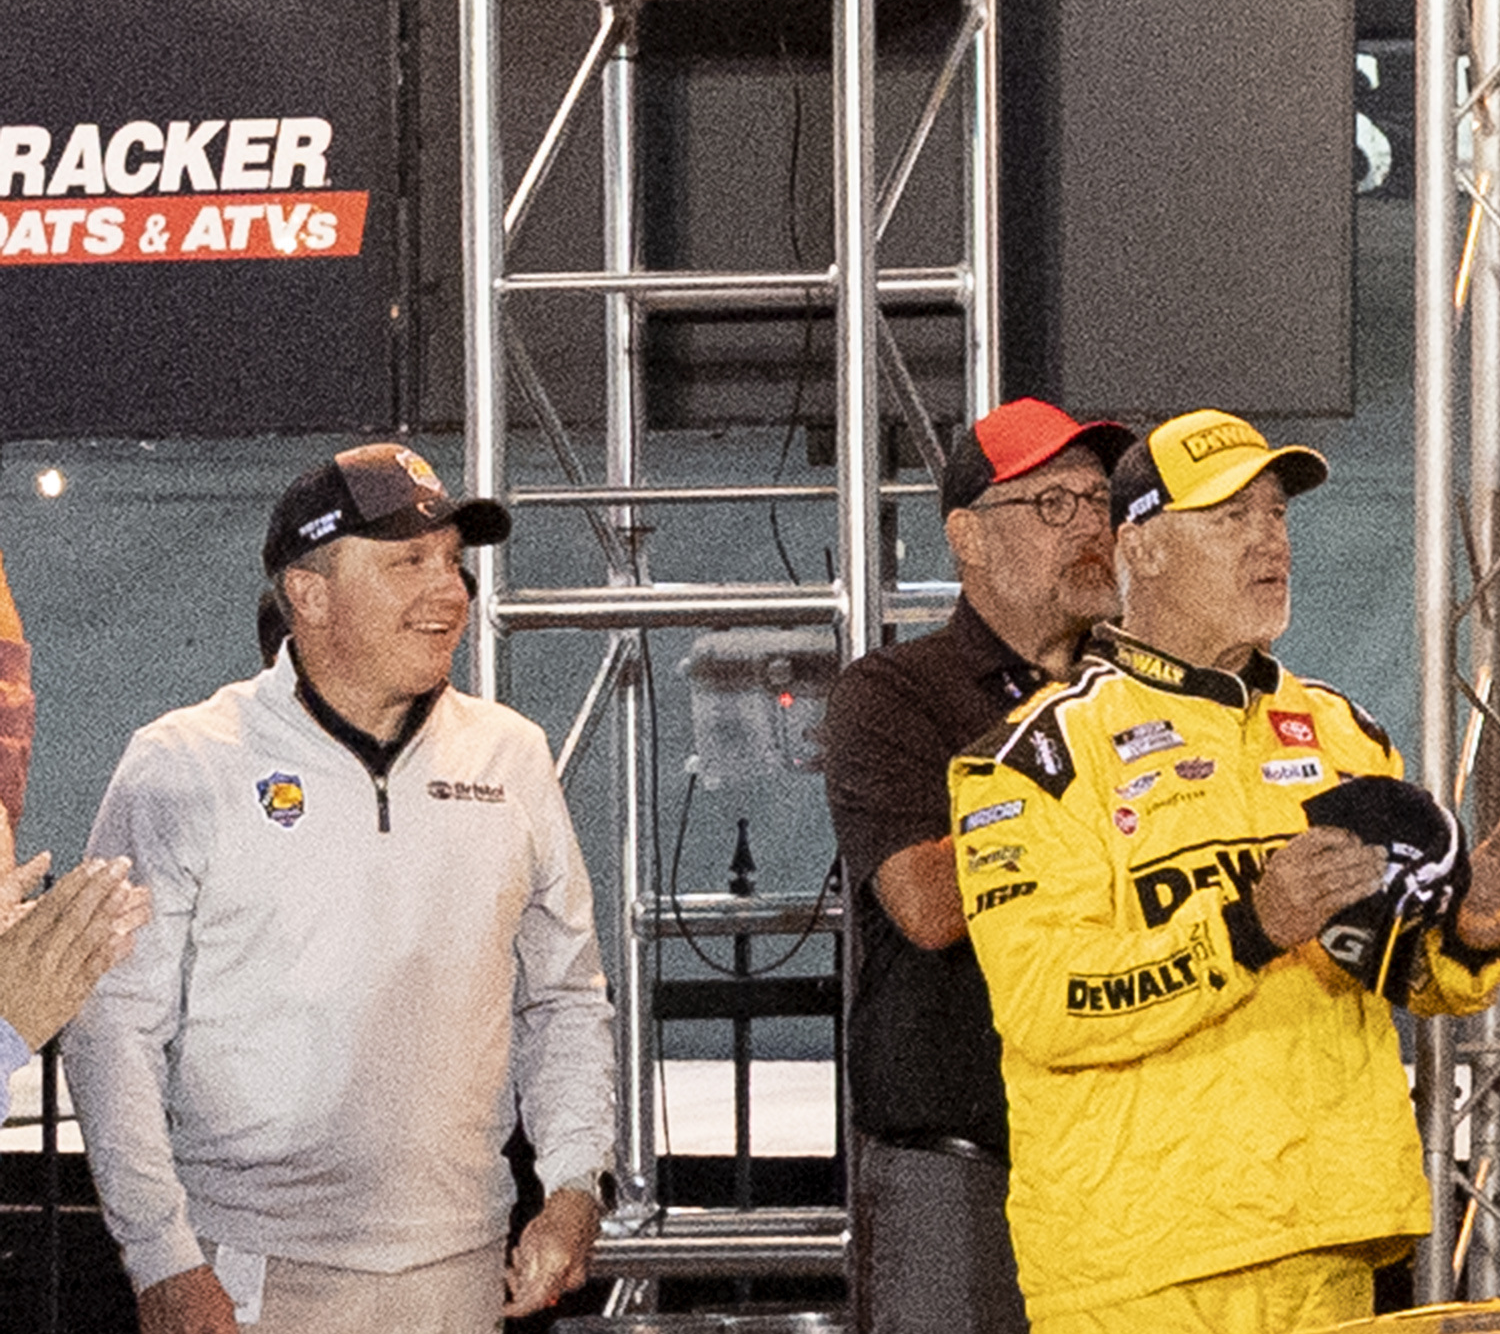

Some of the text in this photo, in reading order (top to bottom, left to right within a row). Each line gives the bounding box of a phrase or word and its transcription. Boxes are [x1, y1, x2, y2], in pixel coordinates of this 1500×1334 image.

[0, 117, 333, 197] RACKER
[0, 203, 338, 255] ATS & ATVs
[1067, 953, 1198, 1011] DEWALT
